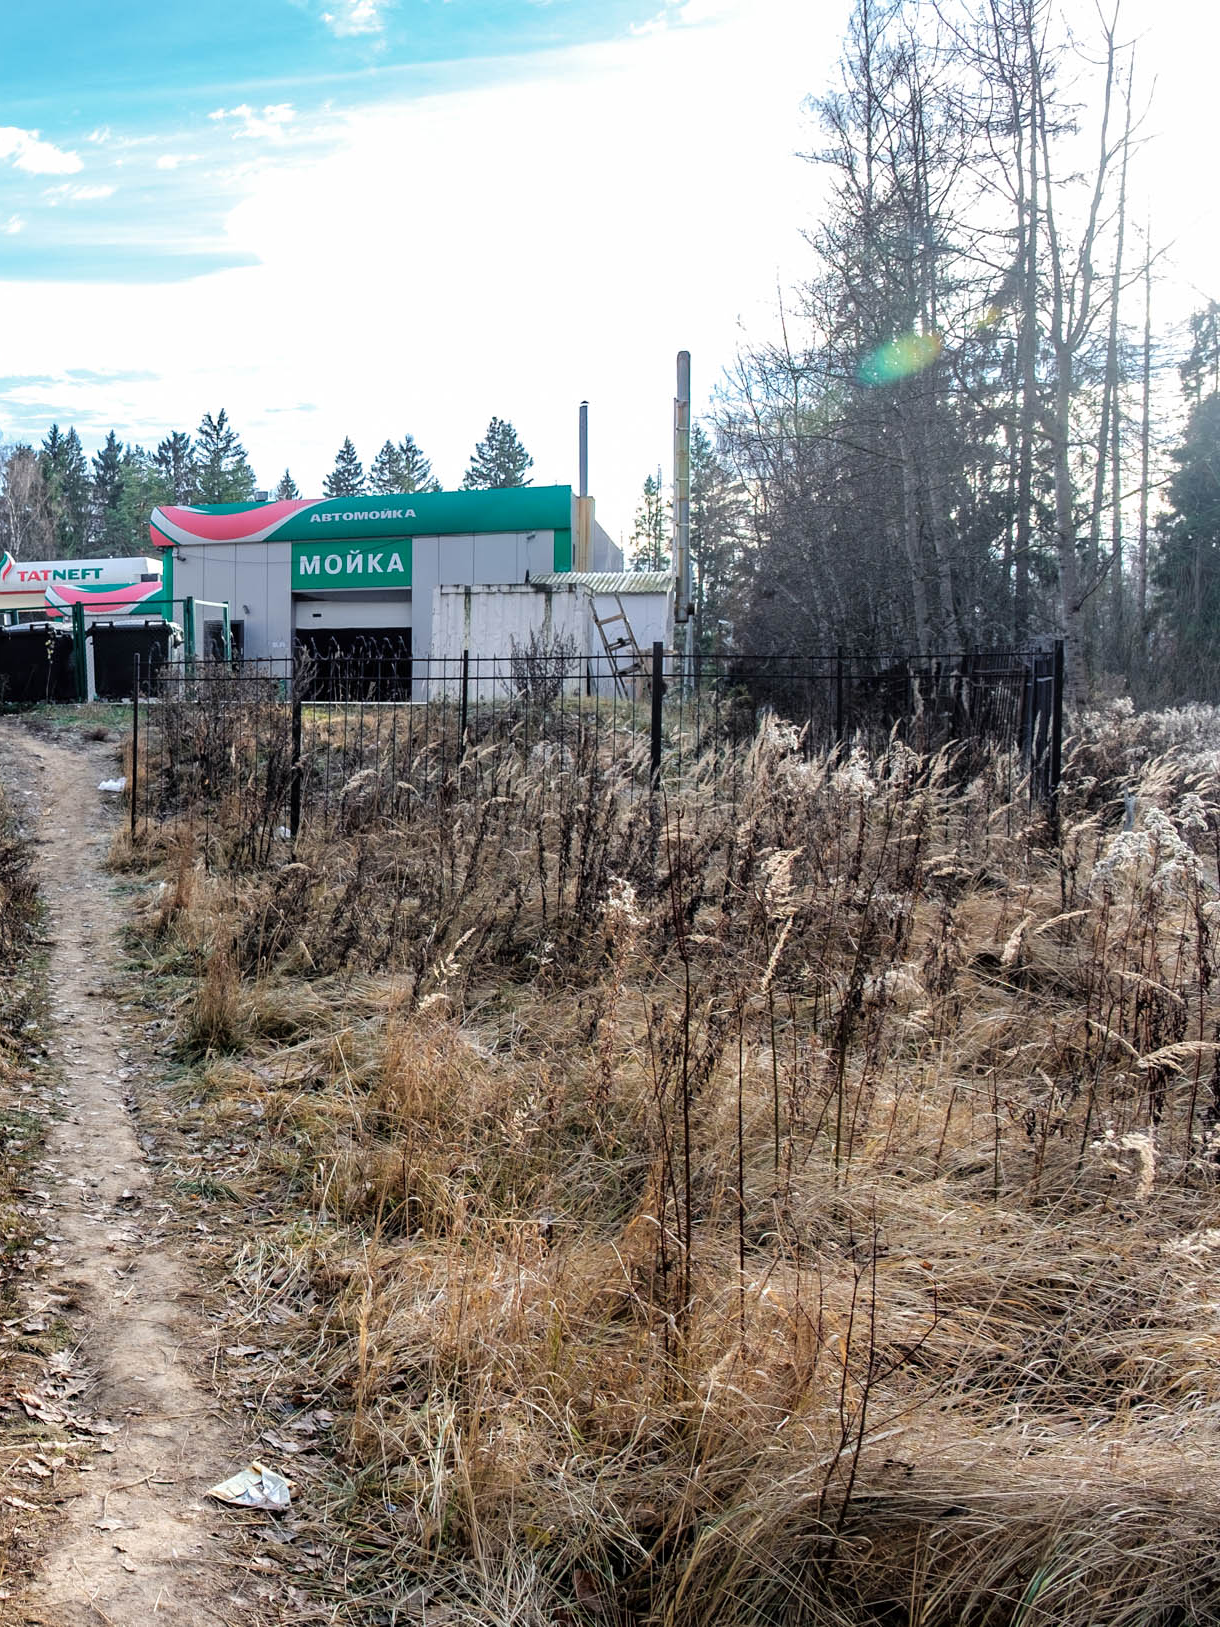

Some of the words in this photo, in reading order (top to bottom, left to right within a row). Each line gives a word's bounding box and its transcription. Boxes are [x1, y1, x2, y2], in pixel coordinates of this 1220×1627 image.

[310, 508, 416, 523] АВТОМОЙКА
[300, 550, 404, 575] МОЙКА
[17, 567, 103, 582] TATNEFT
